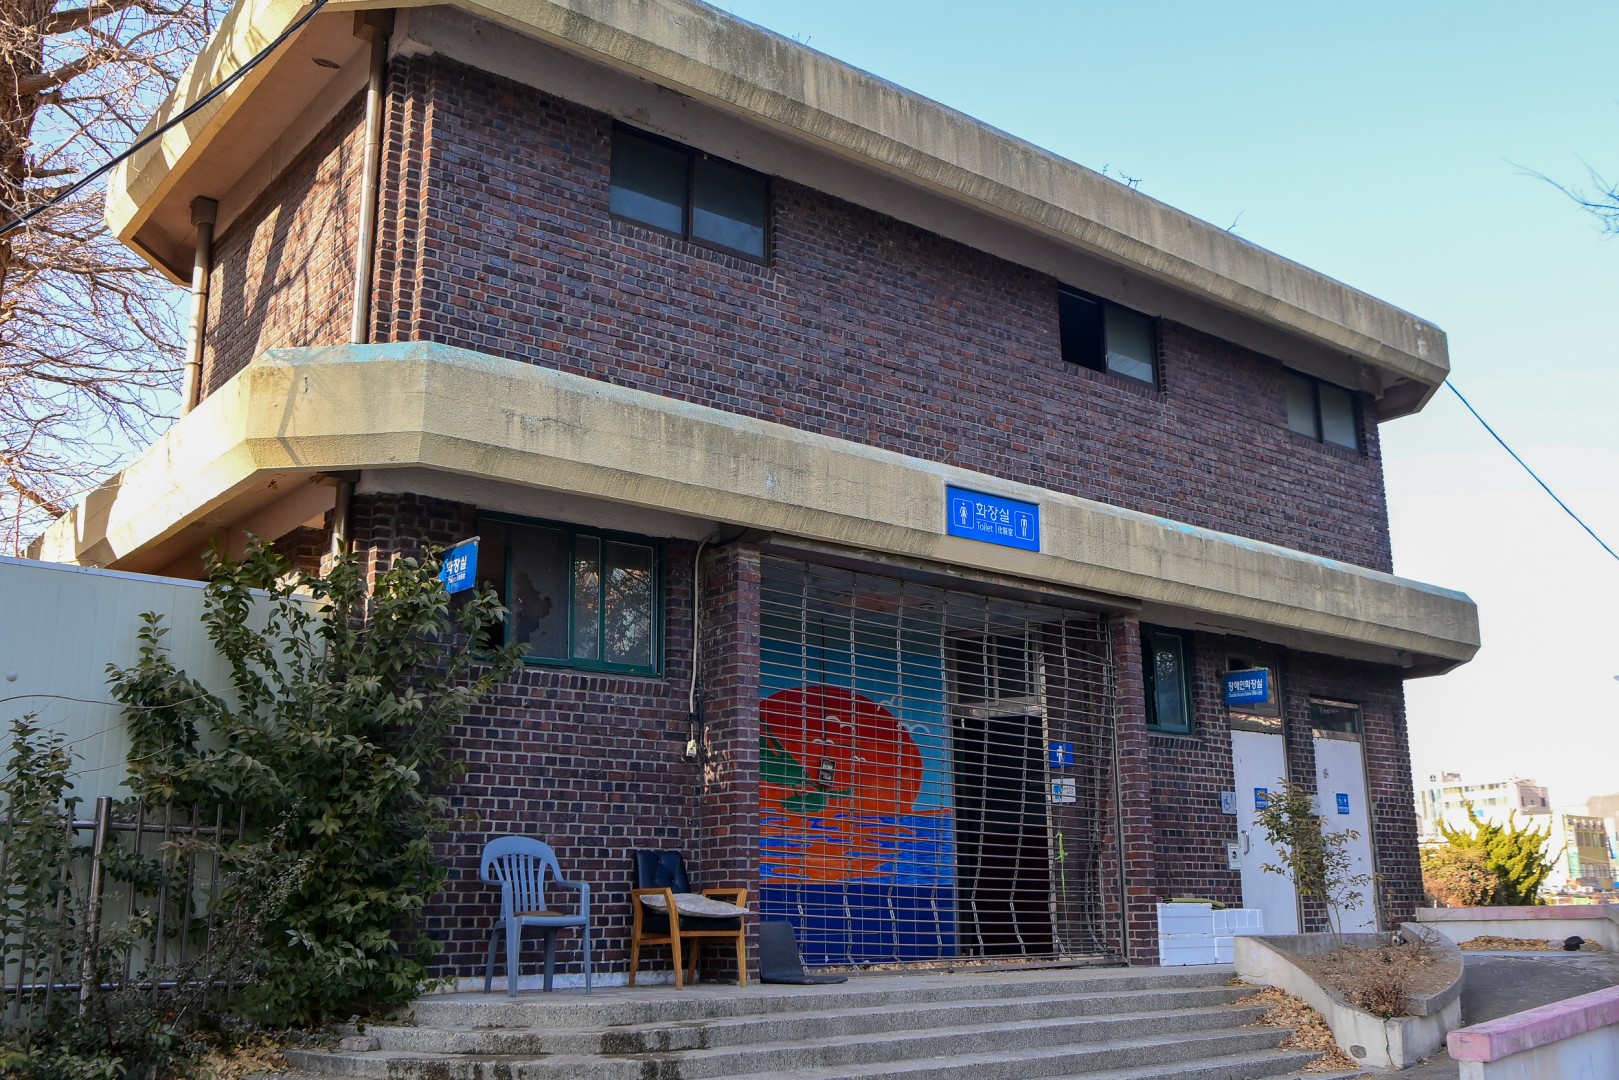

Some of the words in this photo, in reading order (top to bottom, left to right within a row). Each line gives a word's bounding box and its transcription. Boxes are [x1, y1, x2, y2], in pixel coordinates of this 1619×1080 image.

[975, 502, 1010, 524] 화장실
[976, 520, 994, 533] Toilet
[1228, 678, 1263, 692] 장애인화장실
